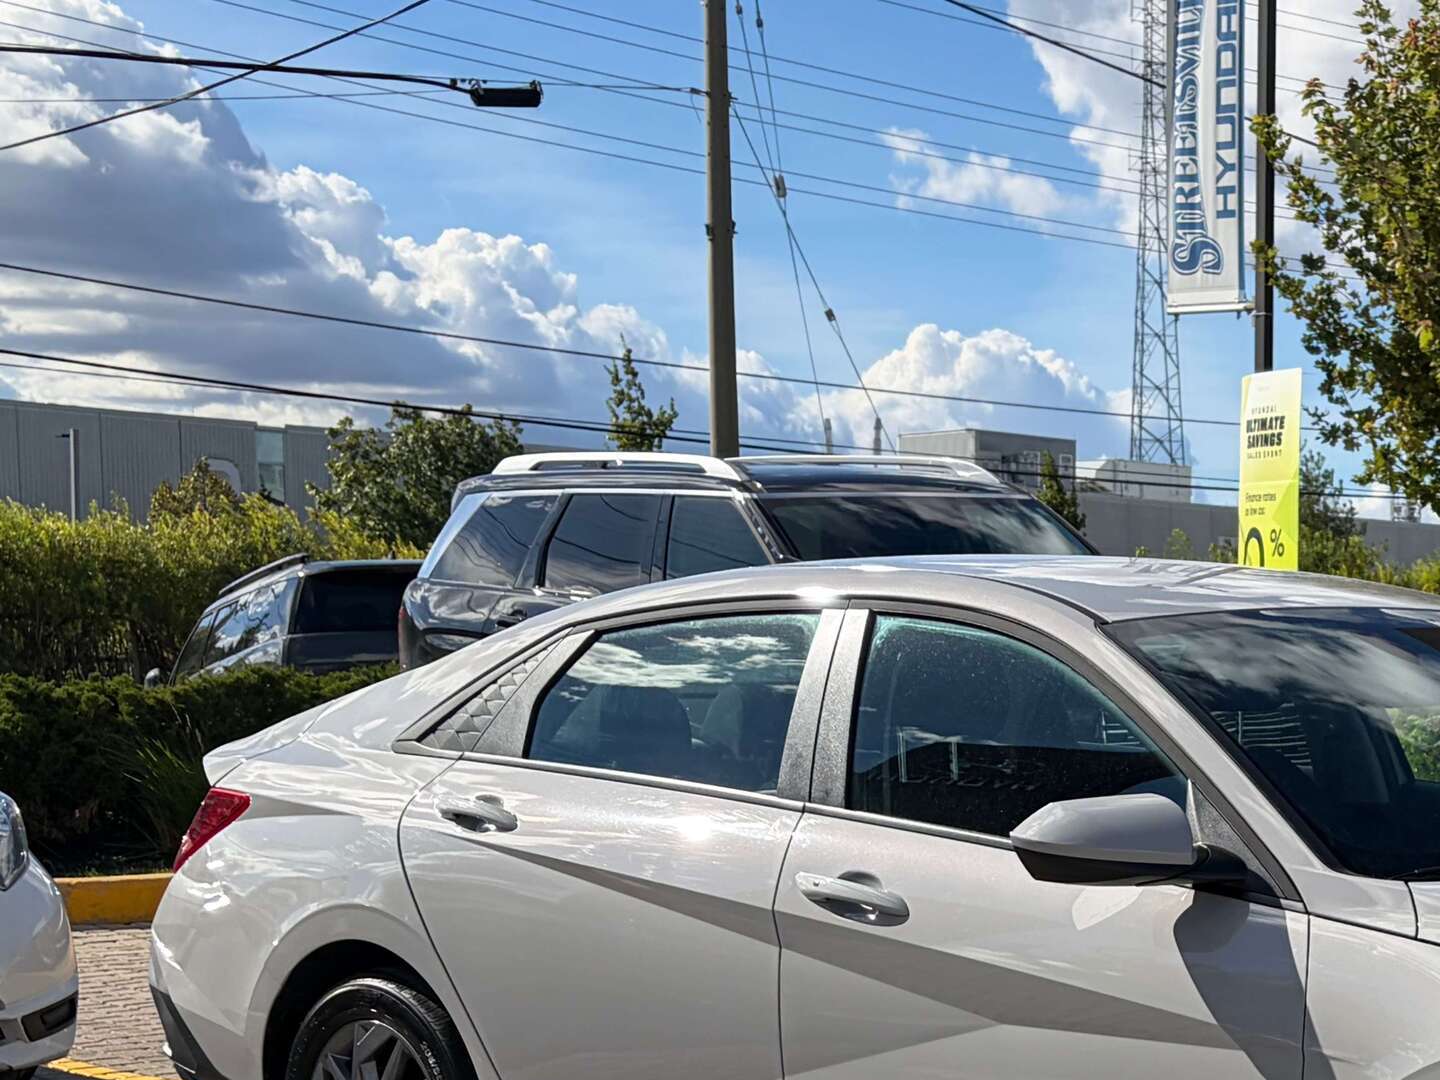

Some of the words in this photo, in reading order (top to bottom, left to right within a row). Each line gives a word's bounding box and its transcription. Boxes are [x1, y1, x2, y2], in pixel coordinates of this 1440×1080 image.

[1170, 0, 1224, 275] STREETSVIL
[1246, 415, 1286, 433] ULTIMATE
[1247, 431, 1283, 449] SAVINGS
